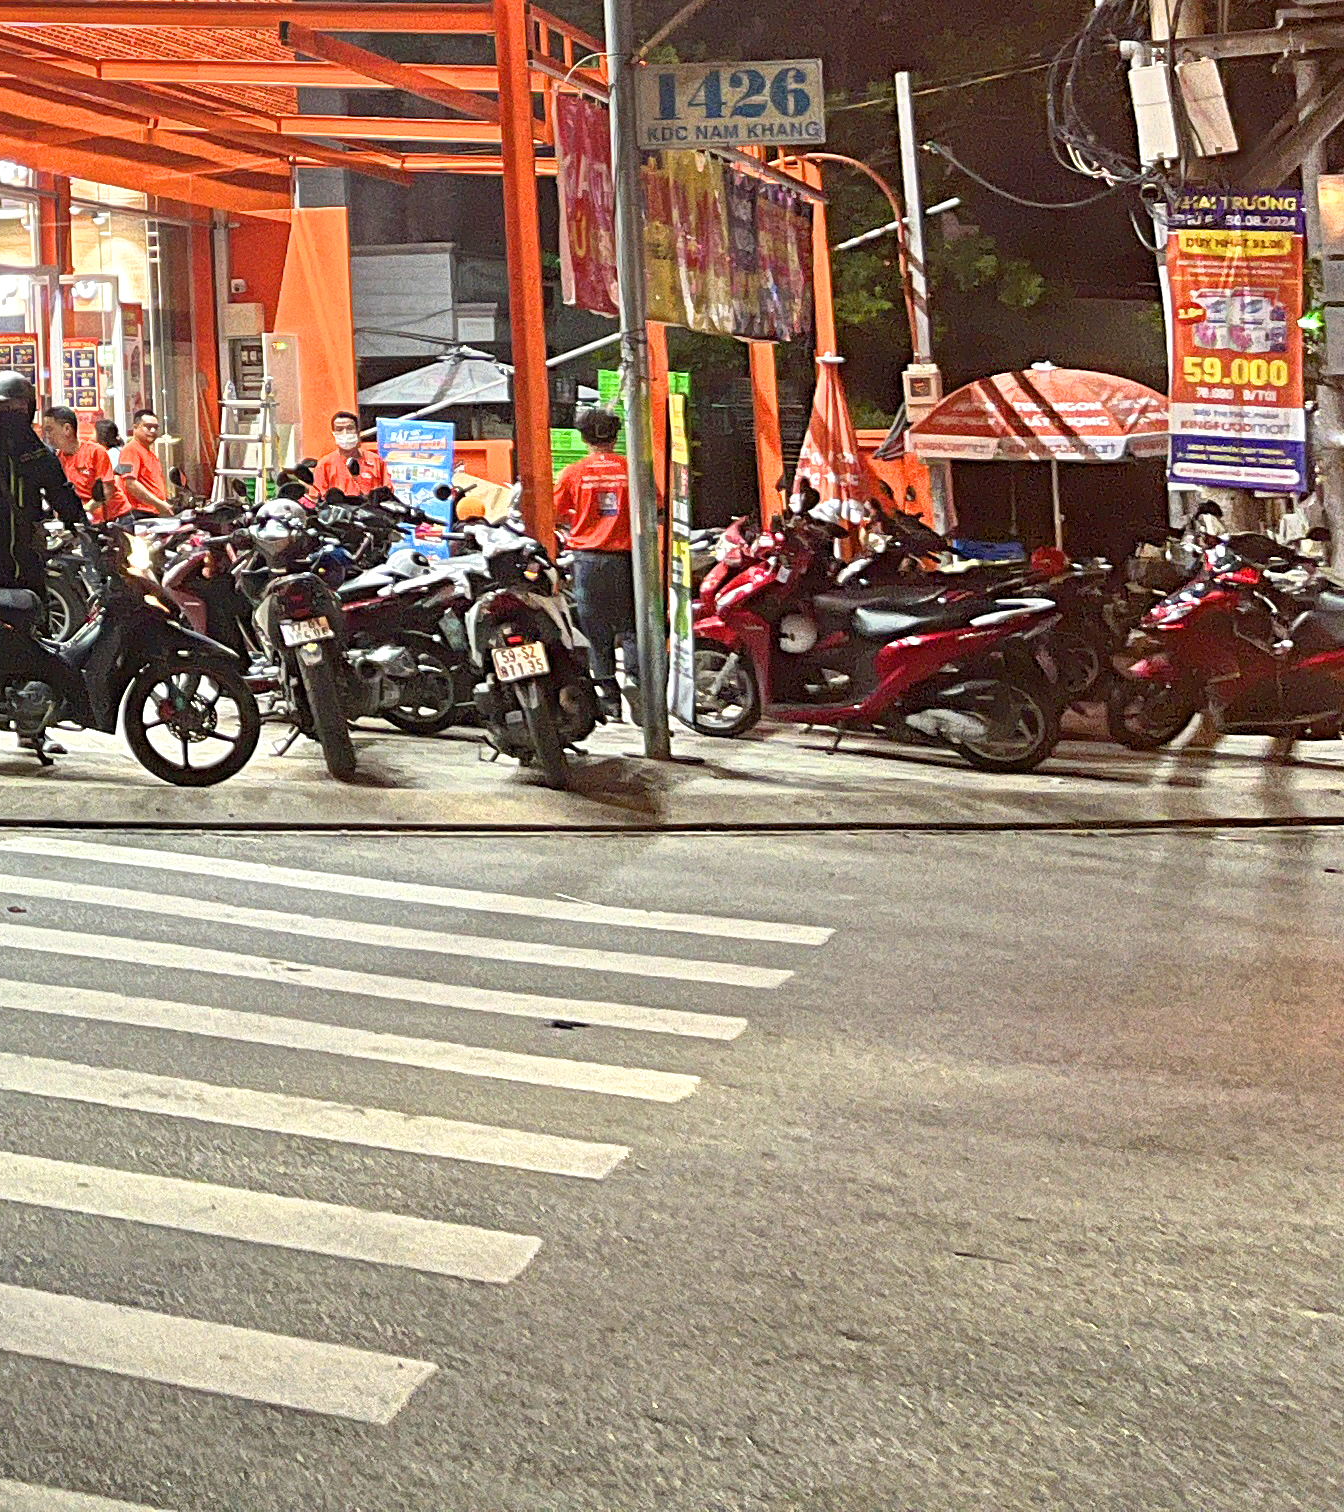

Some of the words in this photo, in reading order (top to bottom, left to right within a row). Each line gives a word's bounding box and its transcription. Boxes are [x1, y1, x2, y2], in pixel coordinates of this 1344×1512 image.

[653, 67, 812, 121] 1426
[647, 126, 688, 142] KDC
[695, 124, 739, 140] NAM
[747, 121, 824, 139] KHANG
[1183, 356, 1289, 387] 59.000
